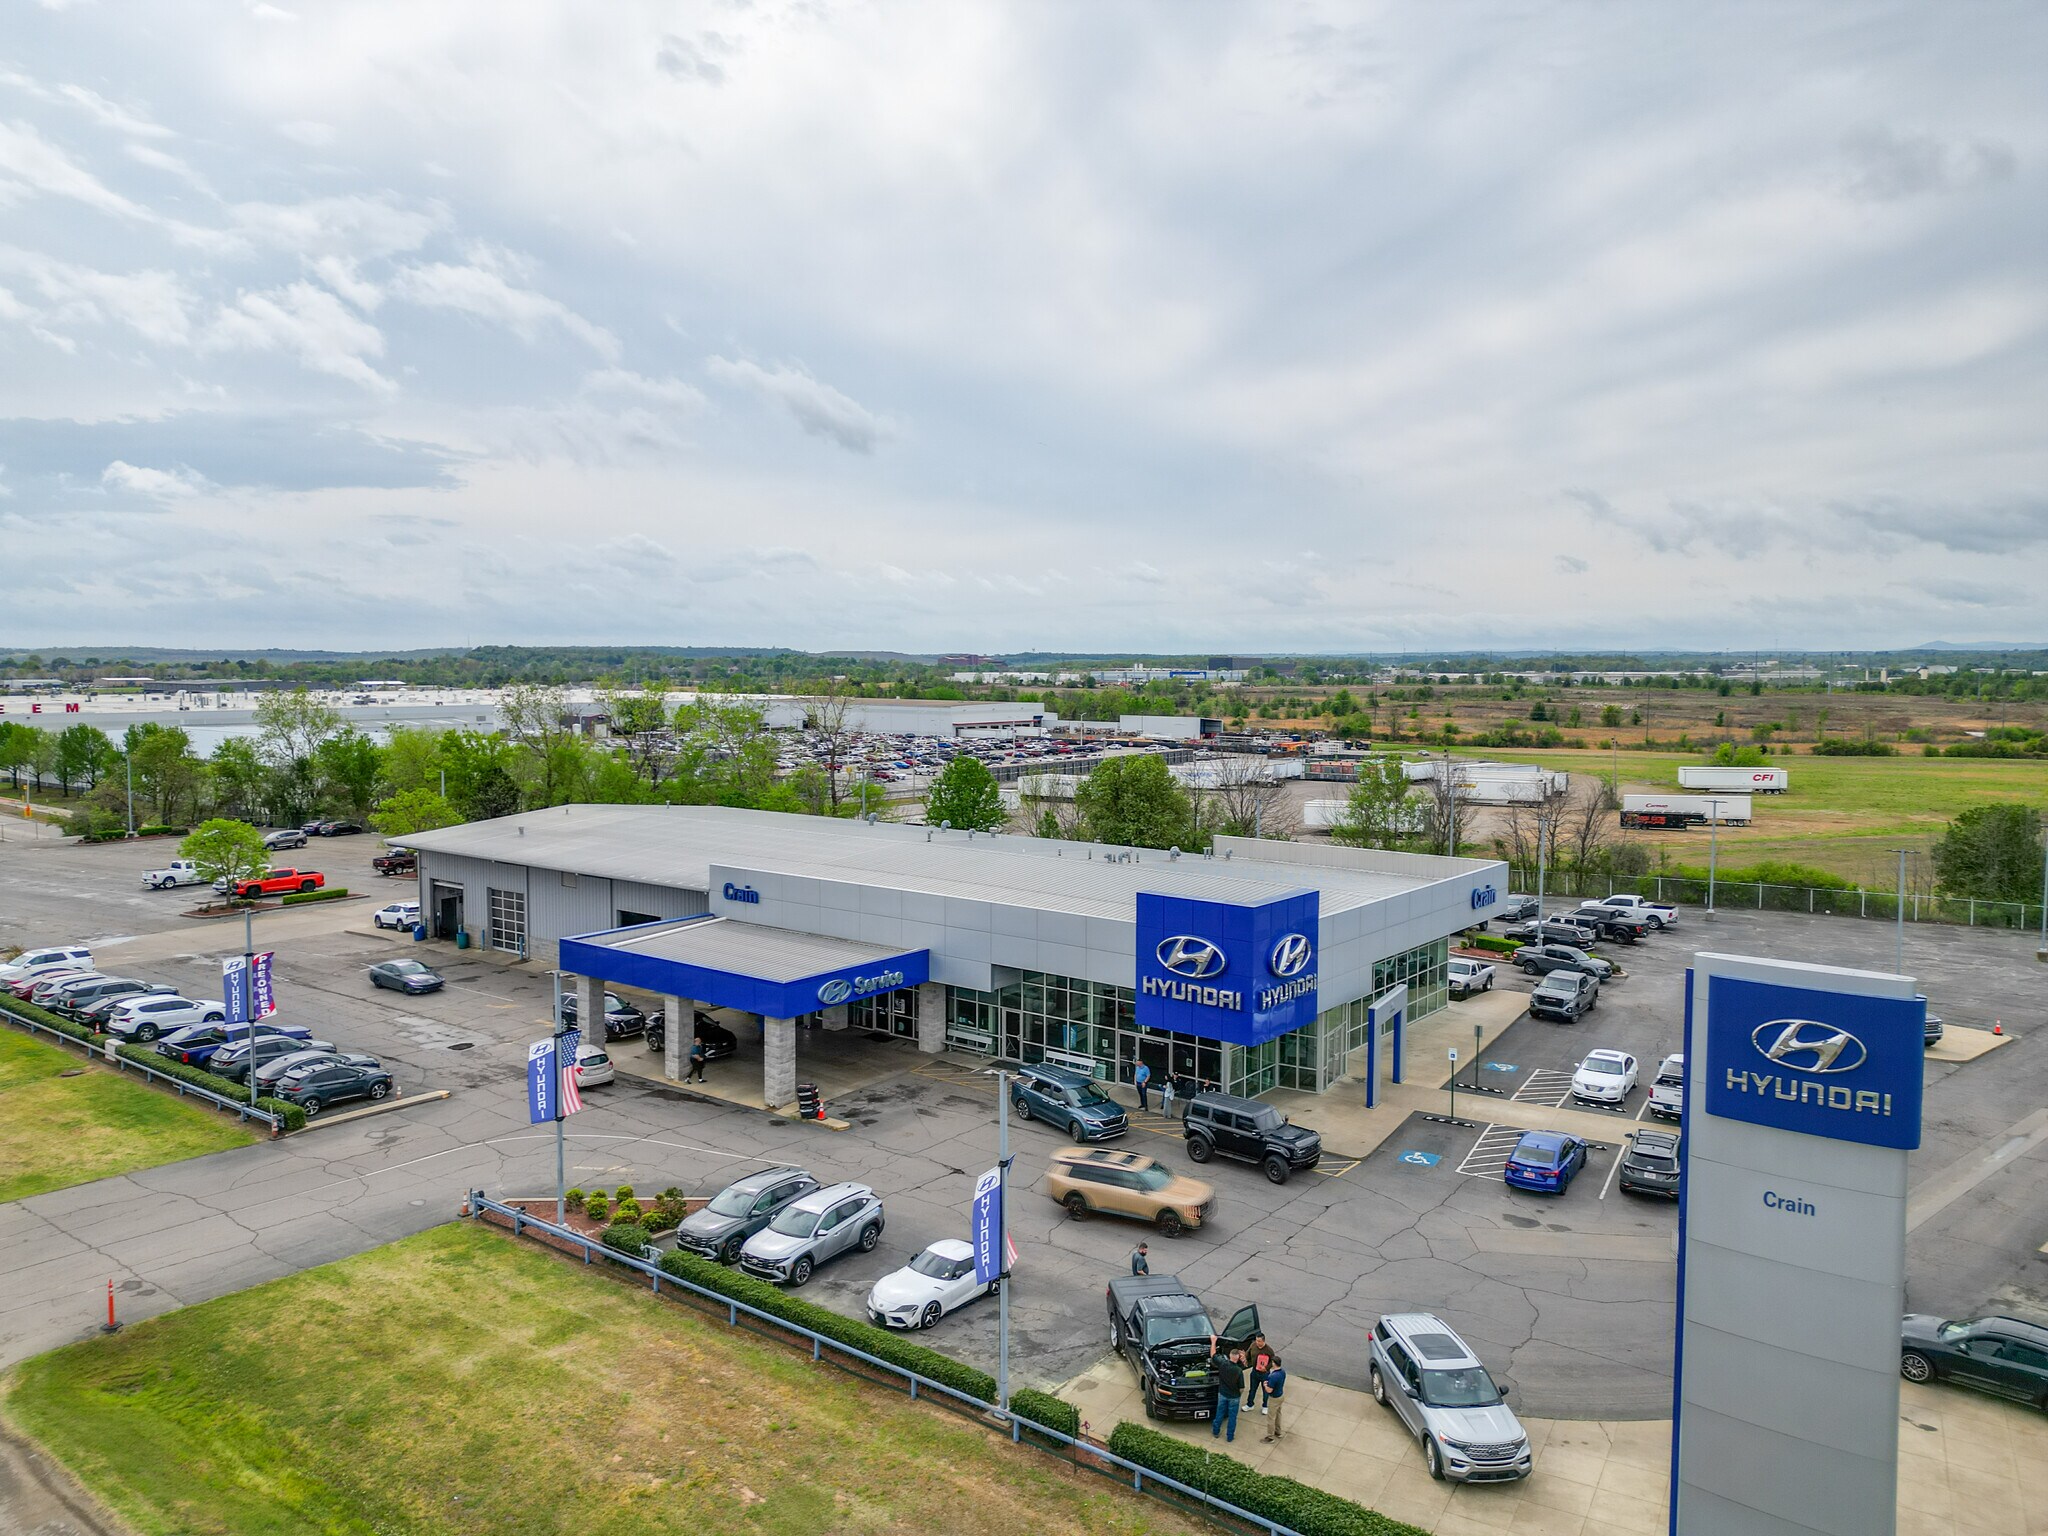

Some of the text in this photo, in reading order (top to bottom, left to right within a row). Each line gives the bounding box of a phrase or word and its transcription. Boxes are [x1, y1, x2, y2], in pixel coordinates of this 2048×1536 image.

[1752, 774, 1774, 782] CFI
[723, 882, 760, 904] Crain
[1471, 884, 1496, 909] Crain
[230, 972, 241, 1022] HYUNDAI
[854, 970, 904, 995] Service
[1142, 975, 1243, 1011] HYUNDAI
[1260, 973, 1317, 1011] HYUNDAI
[536, 1057, 547, 1119] HYUNDAI
[1726, 1068, 1892, 1117] HYUNDAI
[1763, 1191, 1816, 1217] Crain
[980, 1194, 990, 1278] HYUNDAI
